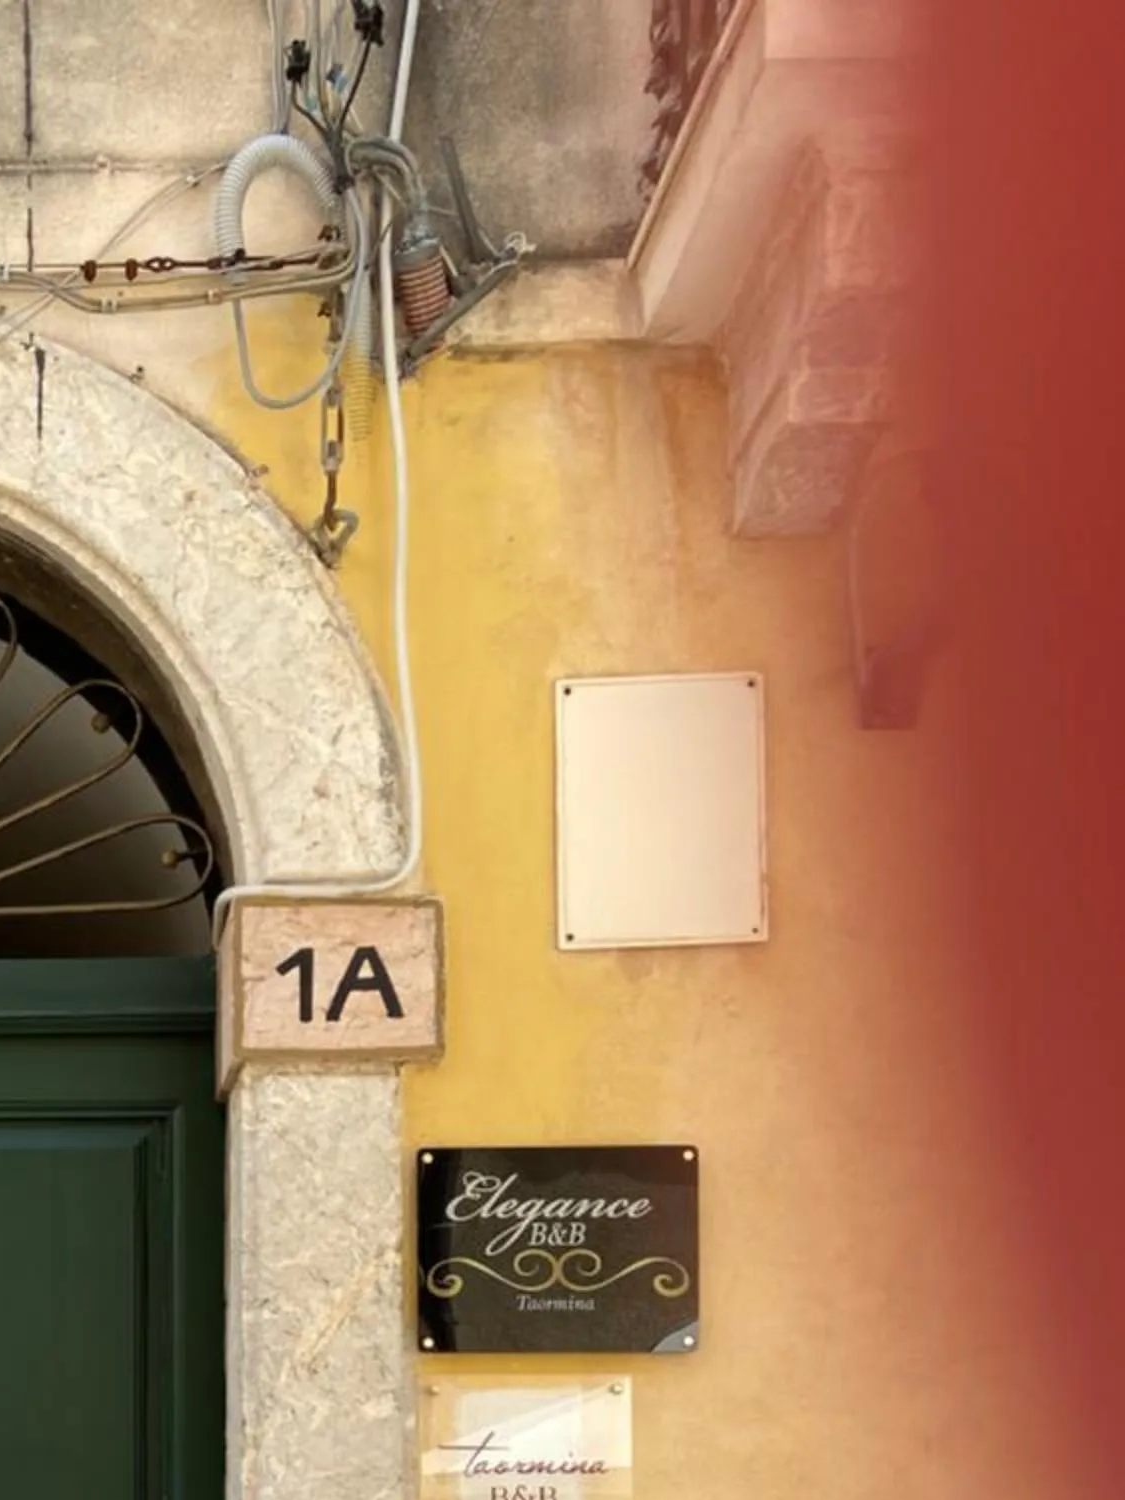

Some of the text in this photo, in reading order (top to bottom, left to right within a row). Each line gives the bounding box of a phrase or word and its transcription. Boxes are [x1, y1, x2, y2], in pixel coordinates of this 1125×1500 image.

[275, 945, 405, 1023] 1A
[445, 1171, 653, 1257] Elegance
[529, 1222, 587, 1246] B&B
[516, 1295, 595, 1312] Taormina
